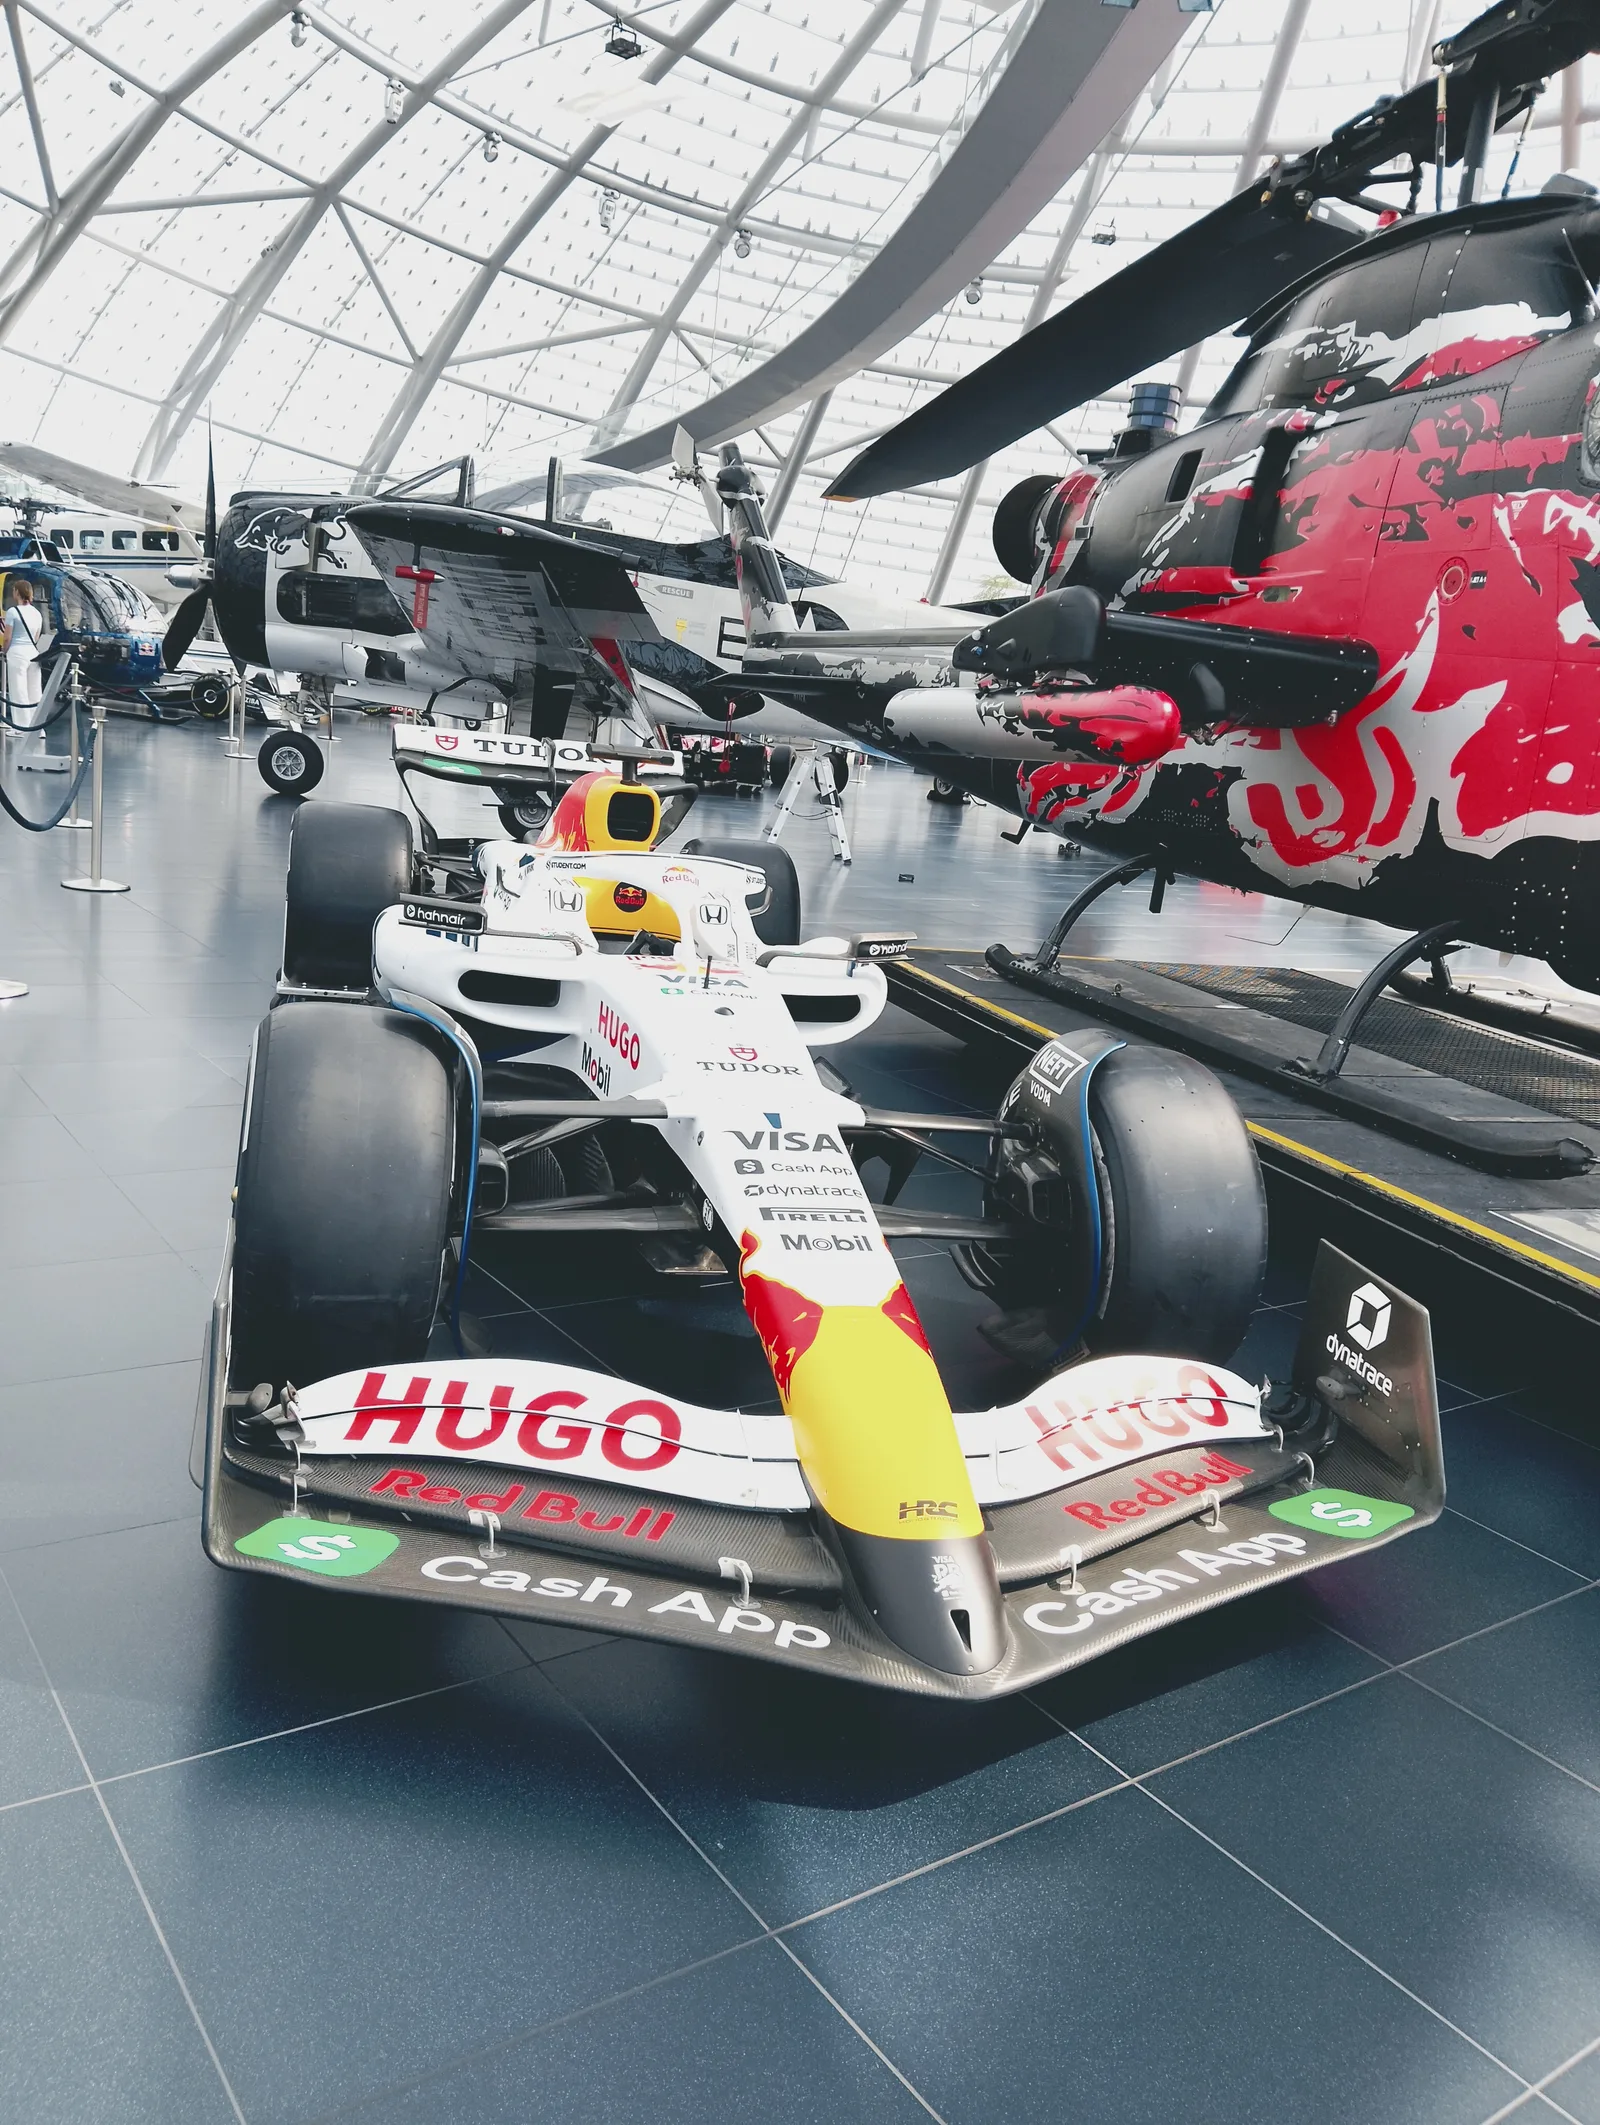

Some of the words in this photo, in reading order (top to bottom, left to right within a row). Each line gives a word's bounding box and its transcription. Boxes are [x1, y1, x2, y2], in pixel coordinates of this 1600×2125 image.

[661, 586, 691, 598] RESCUE
[473, 739, 611, 764] TUO
[662, 874, 682, 884] Red
[683, 875, 700, 887] Bull
[615, 896, 630, 904] Red
[630, 897, 645, 905] Bull
[417, 907, 466, 926] hahnair
[598, 1000, 640, 1070] HUGO
[581, 1041, 611, 1097] Mobil
[696, 1061, 803, 1076] TUDOR
[1036, 1048, 1075, 1080] NEFT
[723, 1129, 844, 1155] VISA
[771, 1162, 815, 1173] Cash
[820, 1164, 853, 1176] App
[766, 1184, 863, 1199] dynatrace
[759, 1207, 868, 1223] PIRELLI
[780, 1234, 873, 1252] Mobil
[1326, 1333, 1393, 1397] dynatrace
[344, 1372, 682, 1471] HUGO
[1024, 1365, 1229, 1472] HUGO
[1063, 1476, 1178, 1530] Red
[1161, 1452, 1255, 1496] Bull
[369, 1471, 525, 1513] Red
[521, 1490, 677, 1541] Bull
[899, 1500, 958, 1520] HRC
[931, 1555, 956, 1564] VISA
[1022, 1568, 1200, 1635] Cash
[1176, 1533, 1307, 1576] App
[420, 1555, 633, 1607] Cash
[648, 1587, 832, 1649] App
